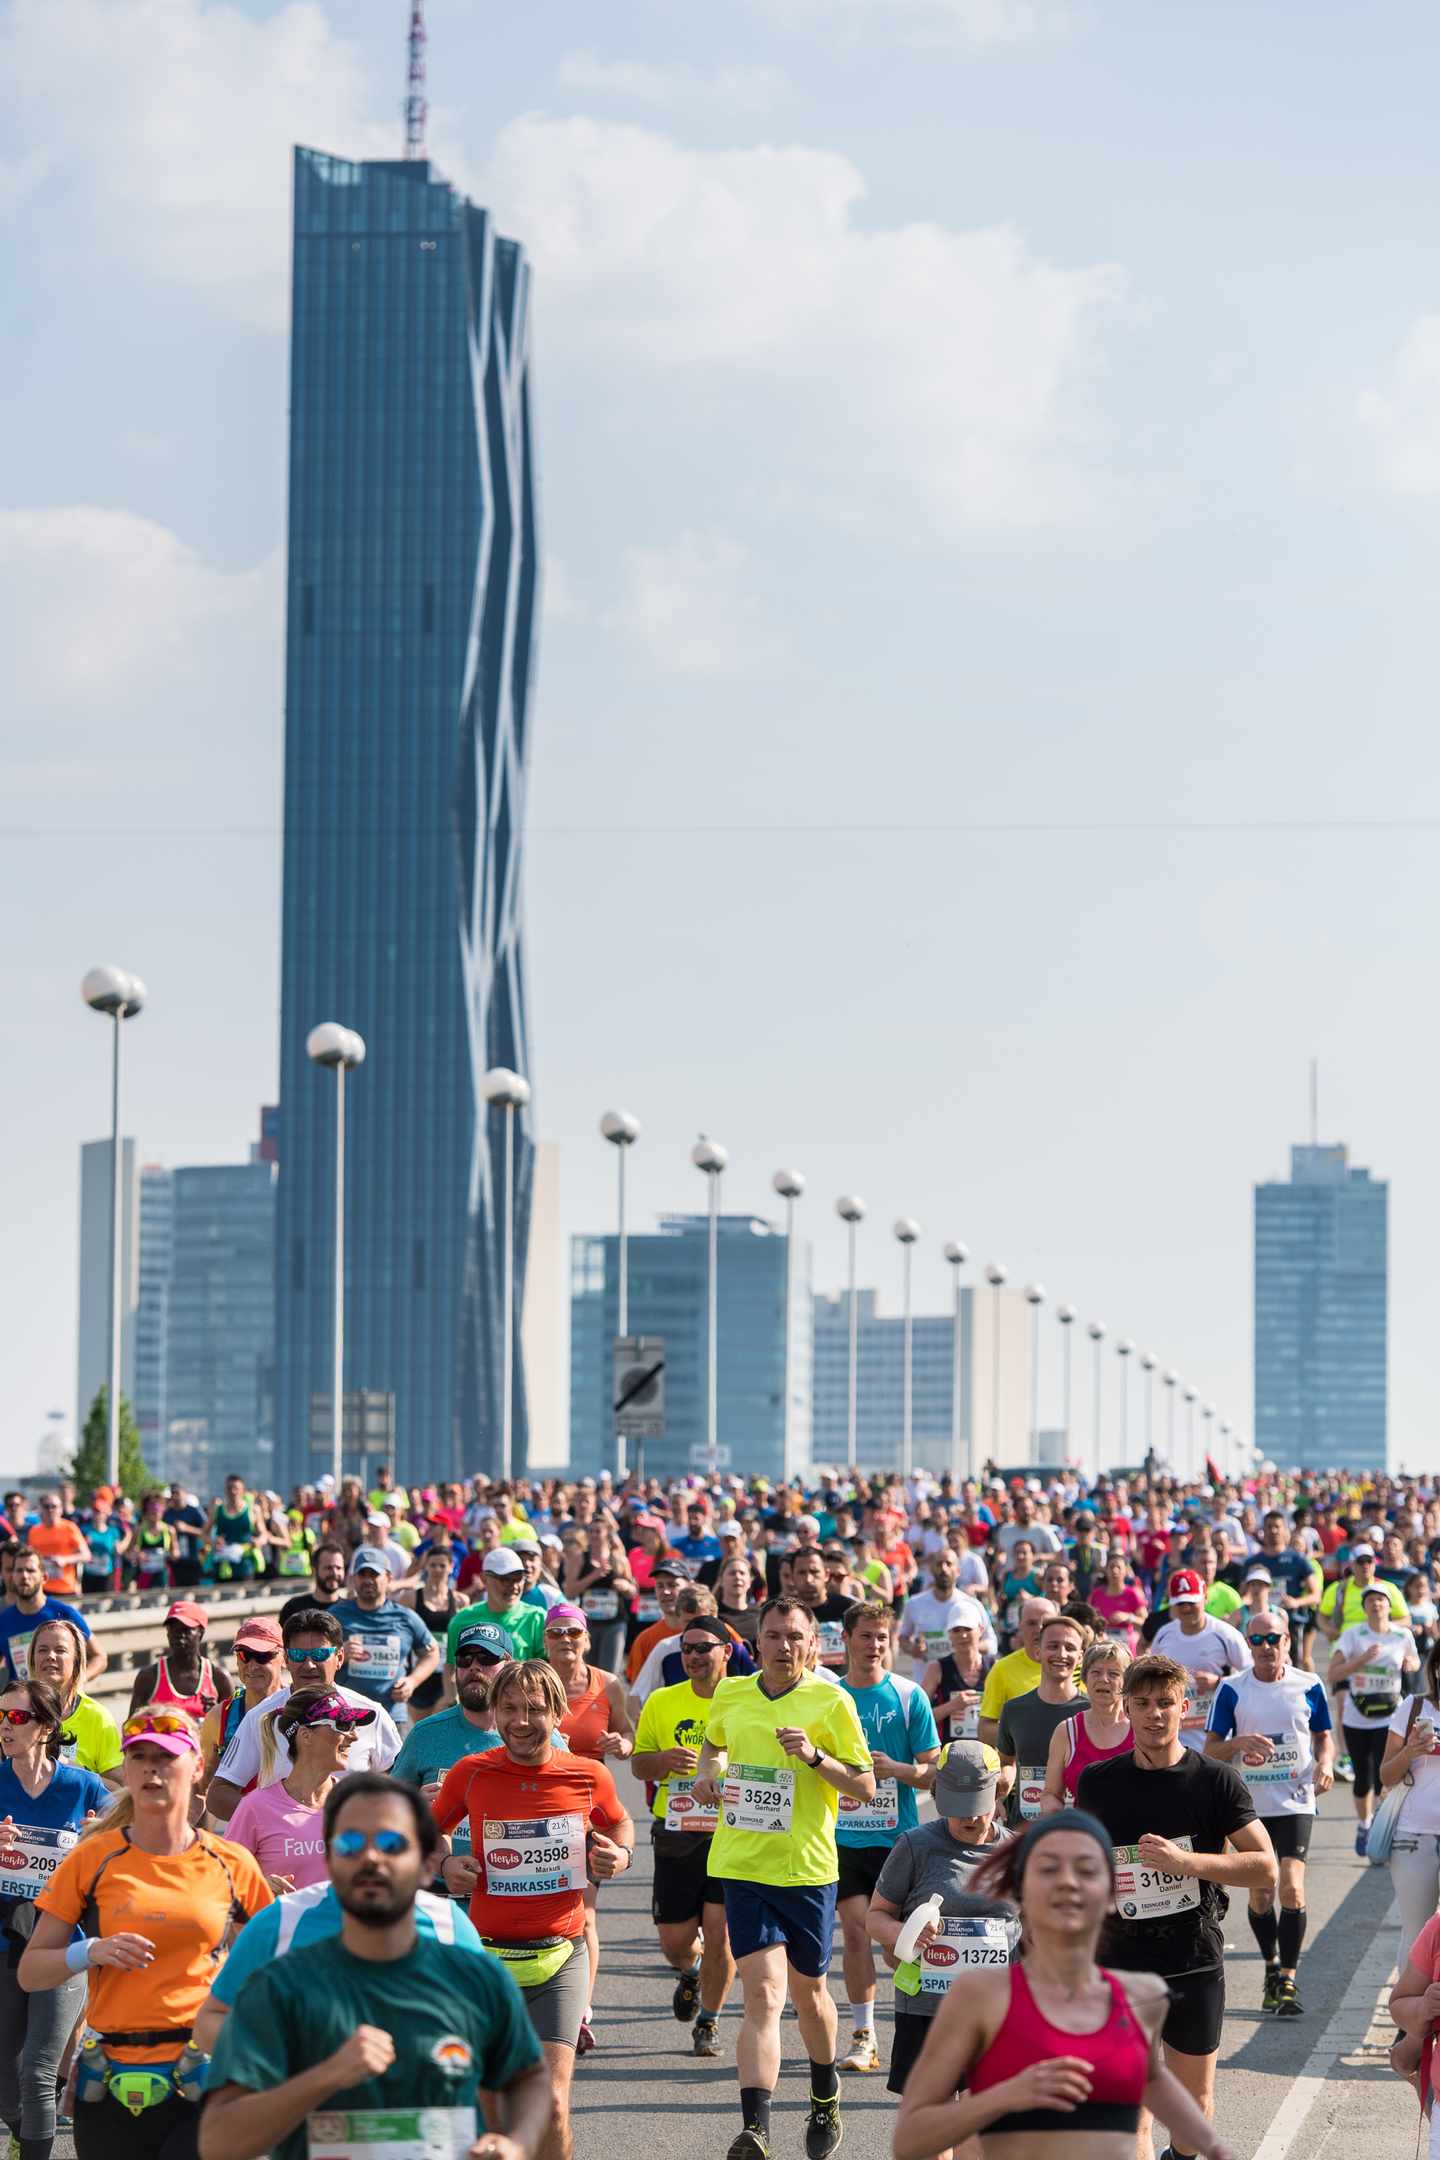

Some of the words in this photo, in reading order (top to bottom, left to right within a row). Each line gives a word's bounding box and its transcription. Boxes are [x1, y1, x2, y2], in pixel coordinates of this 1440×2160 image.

[685, 1735, 705, 1745] WOR
[678, 1781, 697, 1791] ERS
[744, 1789, 782, 1806] 3529
[783, 1798, 791, 1807] A
[754, 1804, 781, 1812] Gerhard
[490, 1852, 519, 1865] Hervis
[523, 1846, 569, 1864] 23598
[29, 1856, 60, 1872] 209
[535, 1865, 561, 1873] Markus
[491, 1879, 557, 1892] SPARKASSE
[1160, 1884, 1182, 1893] Daniel
[927, 1949, 957, 1962] Hervis
[962, 1949, 1008, 1964] 13725
